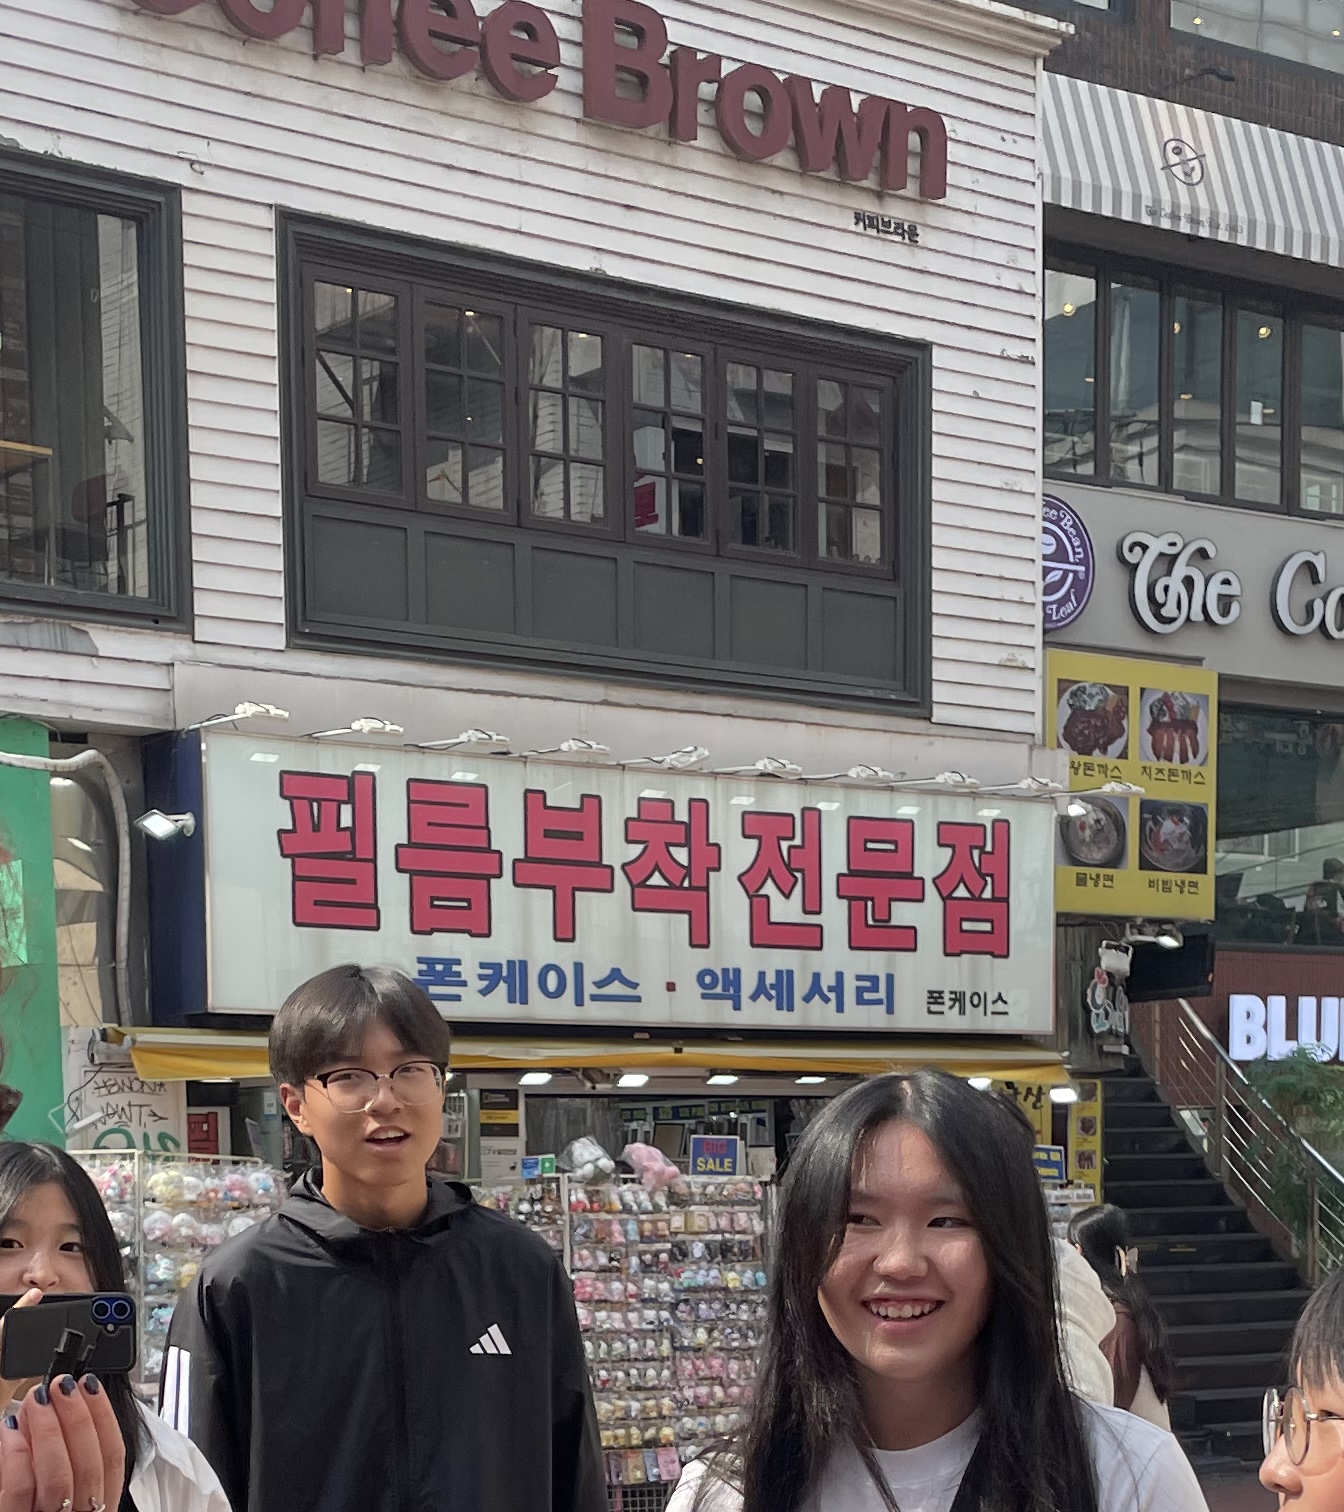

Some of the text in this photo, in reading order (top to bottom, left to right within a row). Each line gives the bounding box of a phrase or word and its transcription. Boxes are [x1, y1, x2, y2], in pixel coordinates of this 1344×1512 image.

[582, 0, 948, 200] Brown
[853, 210, 920, 244] 커피브라운
[1117, 530, 1243, 634] The
[277, 768, 1012, 958] 필름부착전문점
[1075, 871, 1115, 889] 물냉면
[1147, 877, 1200, 896] 비빔냉면
[413, 955, 897, 1016] 폰케이스 액세서리
[925, 987, 1011, 1018] 폰케이스
[696, 1157, 733, 1173] SALE
